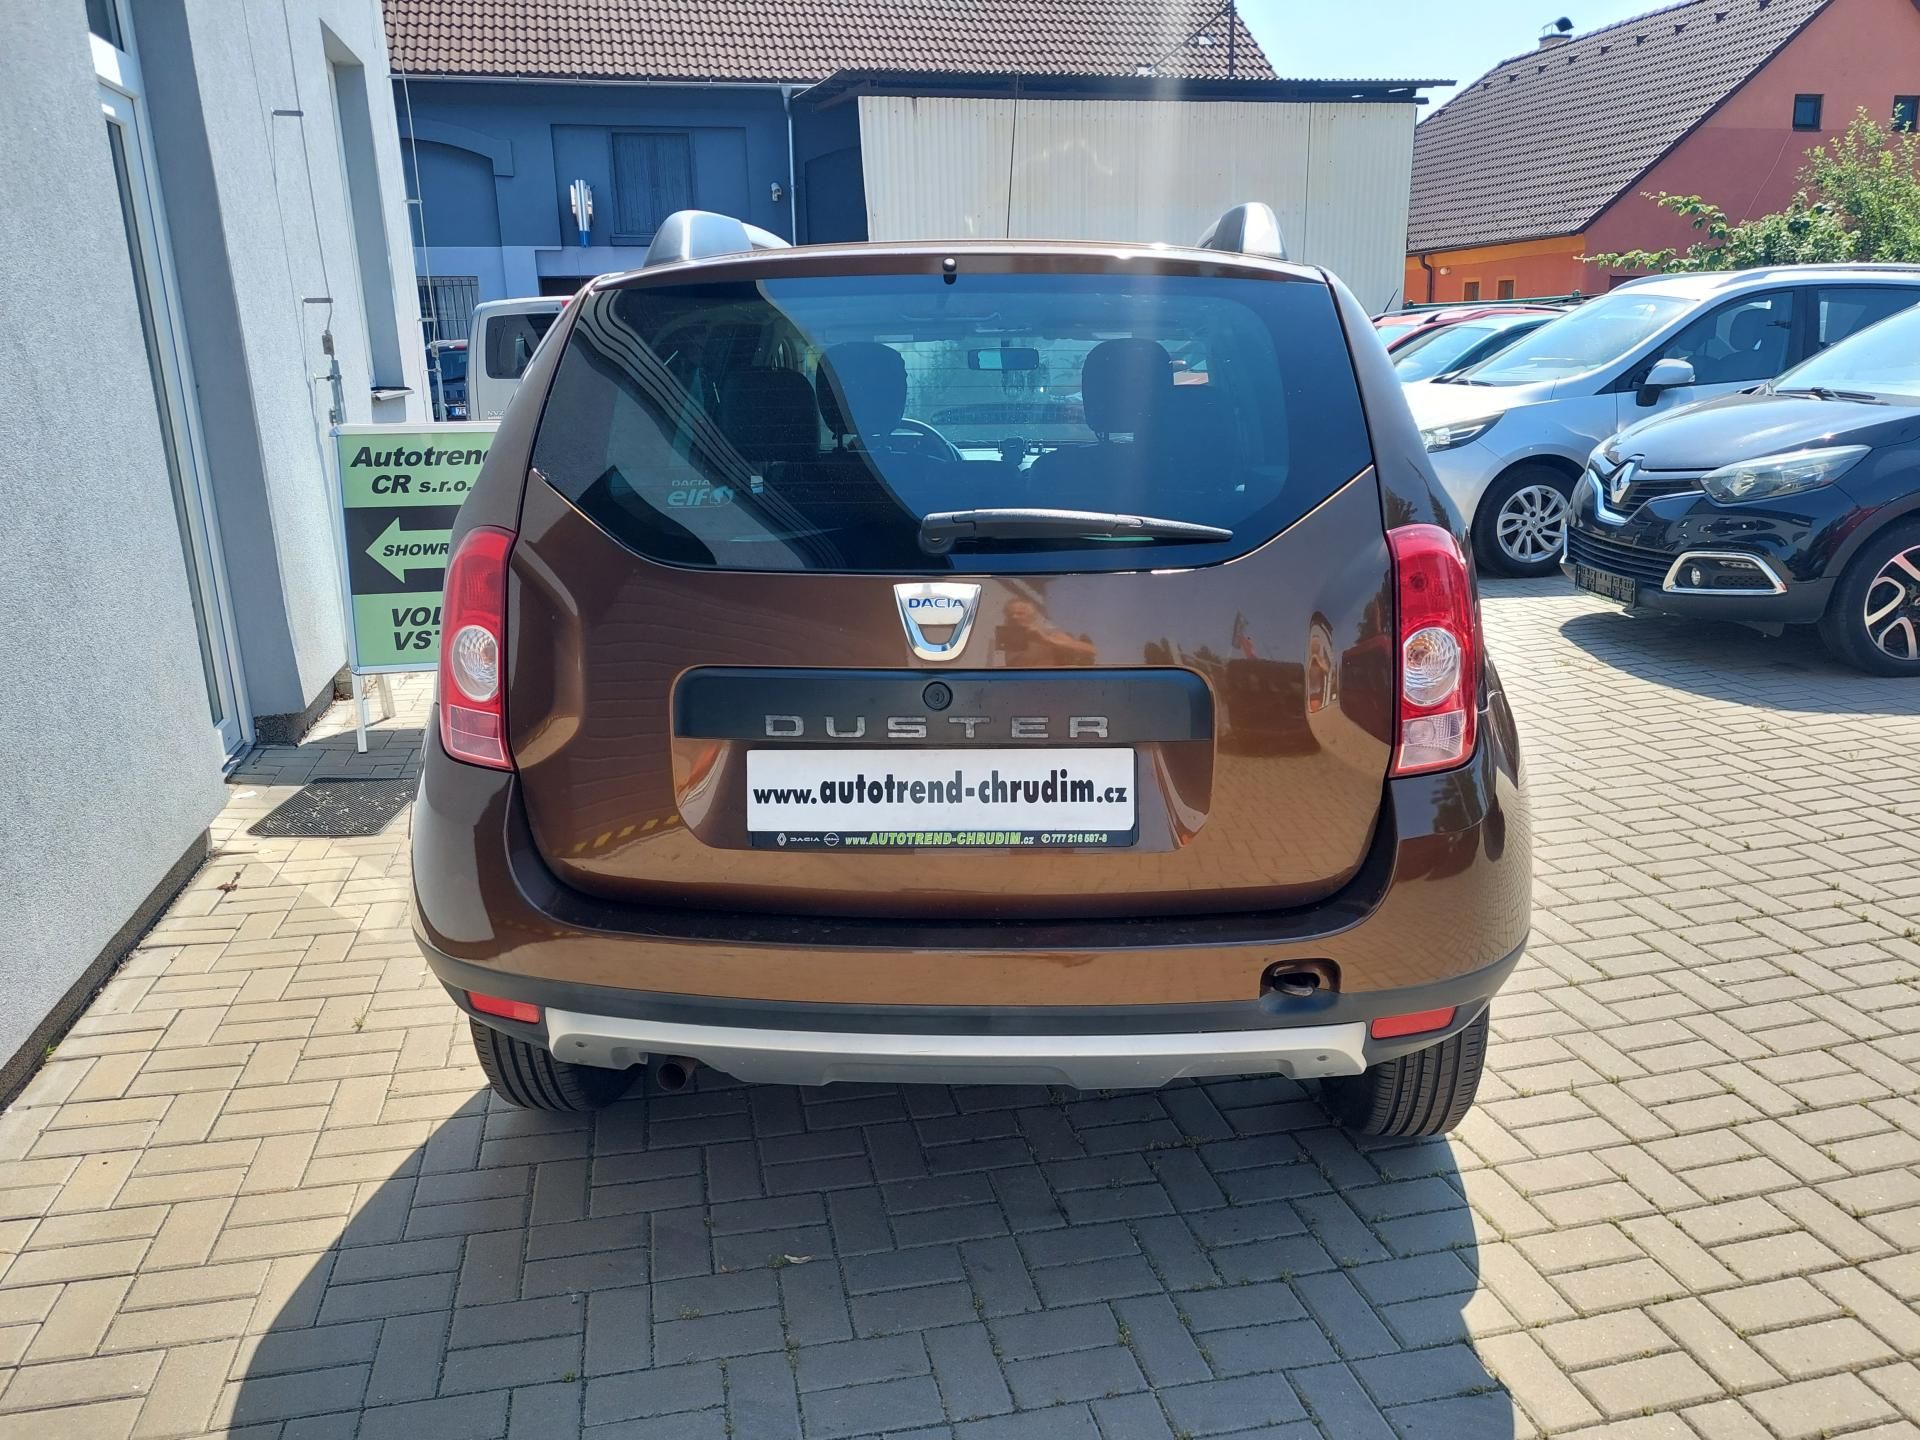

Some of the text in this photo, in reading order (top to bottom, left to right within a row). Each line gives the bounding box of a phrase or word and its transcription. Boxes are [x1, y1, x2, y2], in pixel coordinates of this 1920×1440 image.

[371, 474, 472, 494] CR s.r.o.
[671, 479, 711, 487] DACIA
[667, 487, 711, 506] elf
[908, 598, 964, 608] DACIA
[764, 714, 1109, 739] DUSTER
[753, 768, 1127, 804] www.autotrend-chrudim.cz
